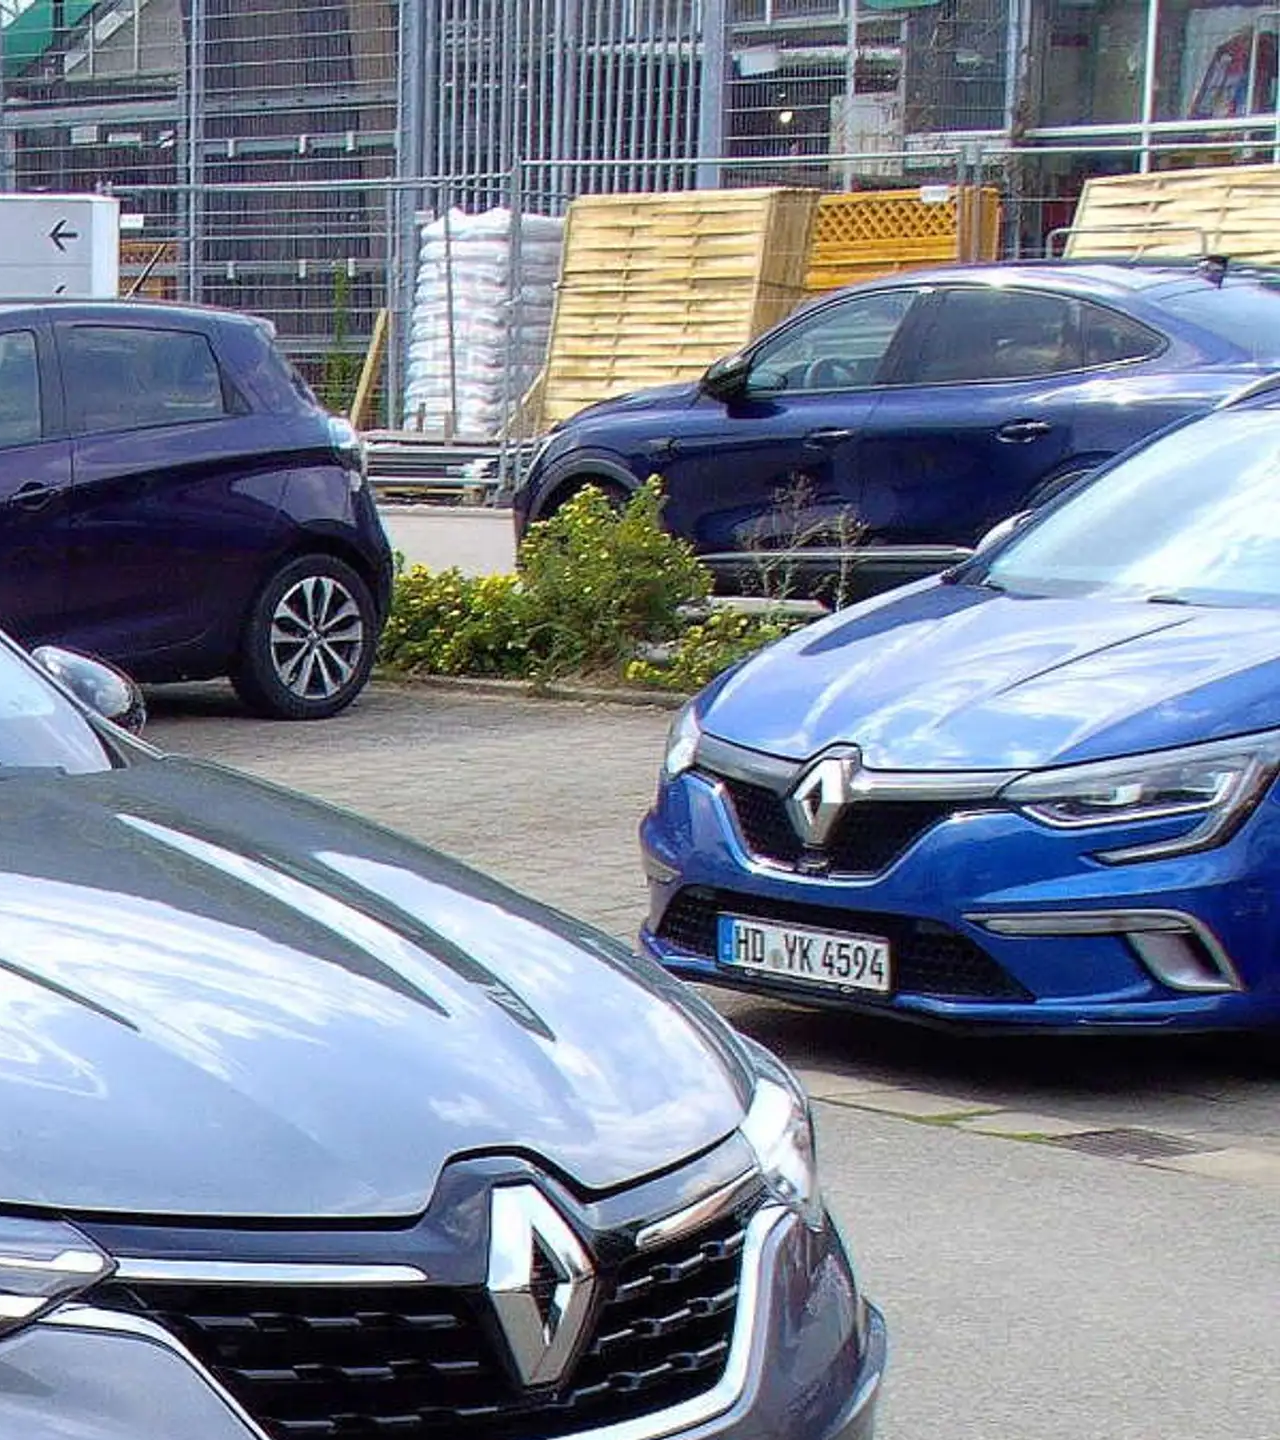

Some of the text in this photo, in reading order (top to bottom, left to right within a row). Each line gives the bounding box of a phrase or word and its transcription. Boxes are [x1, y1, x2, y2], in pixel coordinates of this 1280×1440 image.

[737, 926, 884, 984] HD YK 4594
